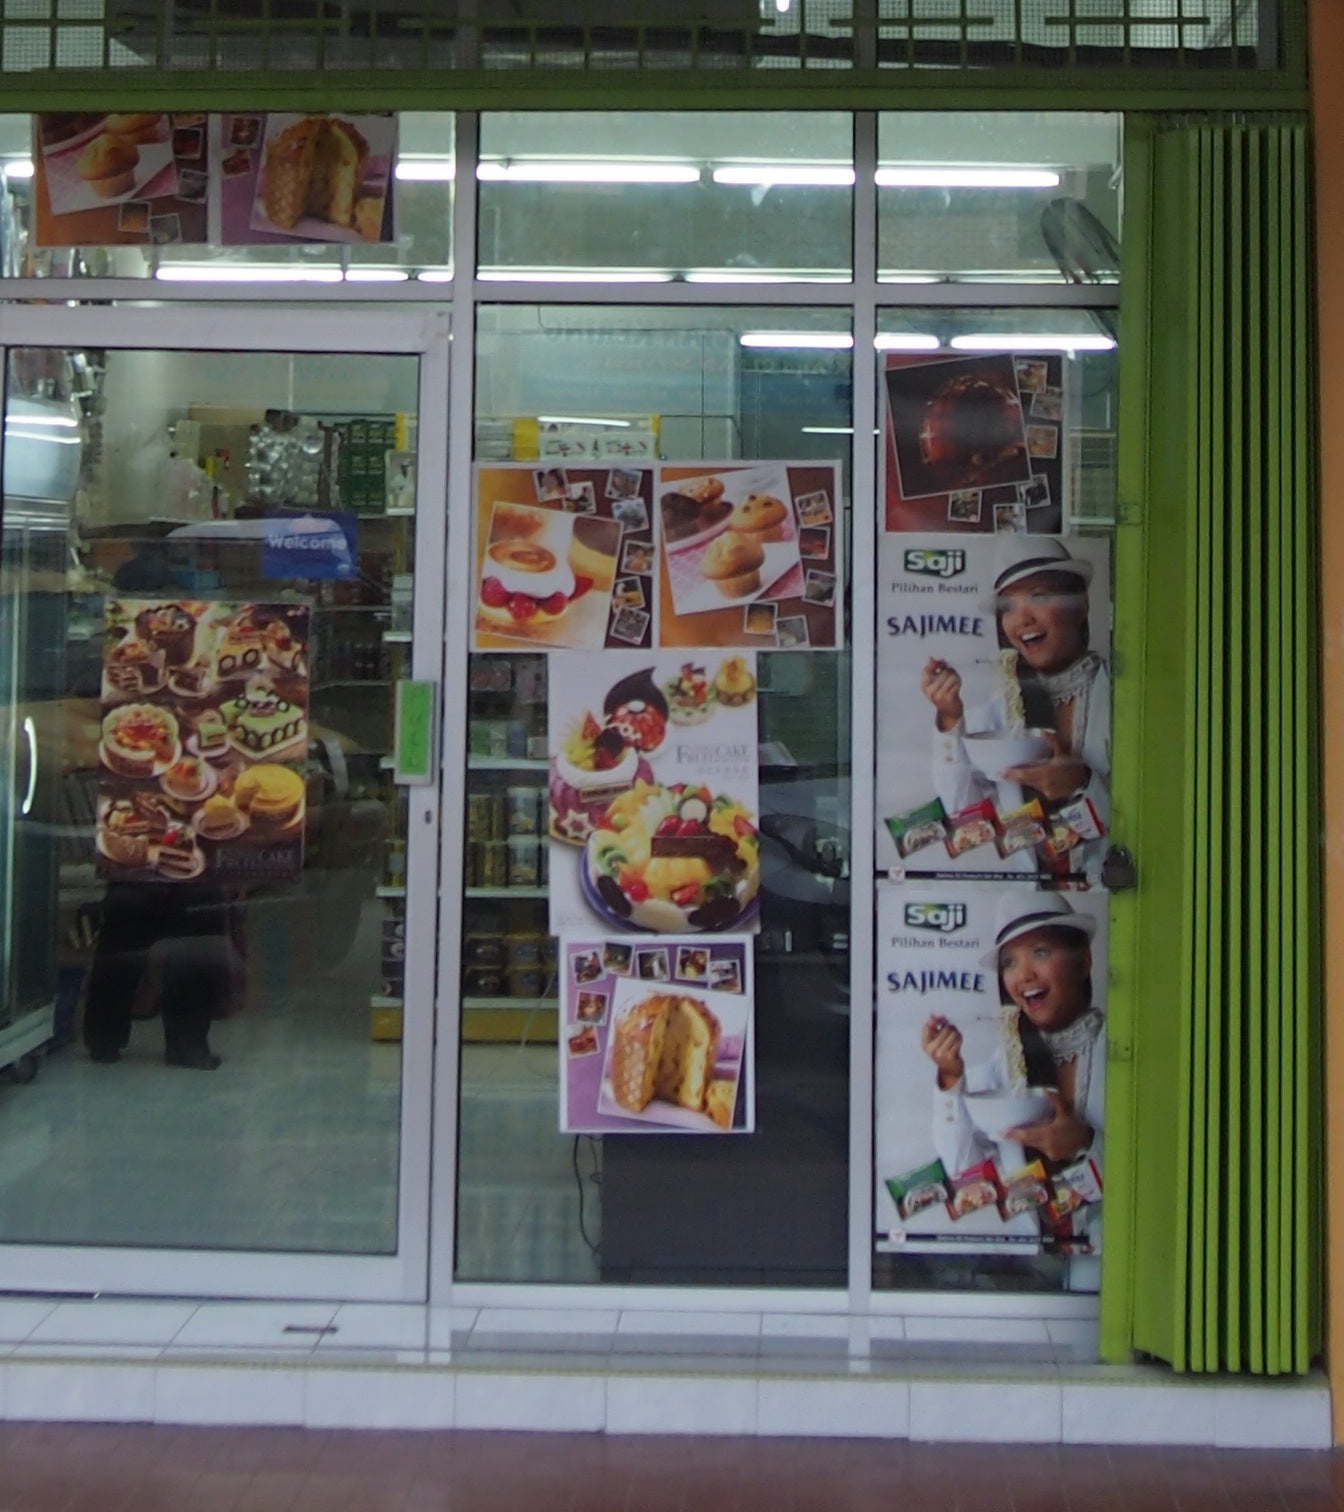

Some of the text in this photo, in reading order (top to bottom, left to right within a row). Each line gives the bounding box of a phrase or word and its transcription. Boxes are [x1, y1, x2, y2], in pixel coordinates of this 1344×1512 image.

[265, 534, 348, 550] Welcome
[906, 550, 963, 577] Saji
[891, 582, 979, 593] Pilihan Bestari
[886, 614, 984, 639] SAJIMEE
[906, 904, 964, 932] Saji
[891, 937, 980, 949] Pilihan Bestari
[886, 970, 985, 995] SAJIMEE
